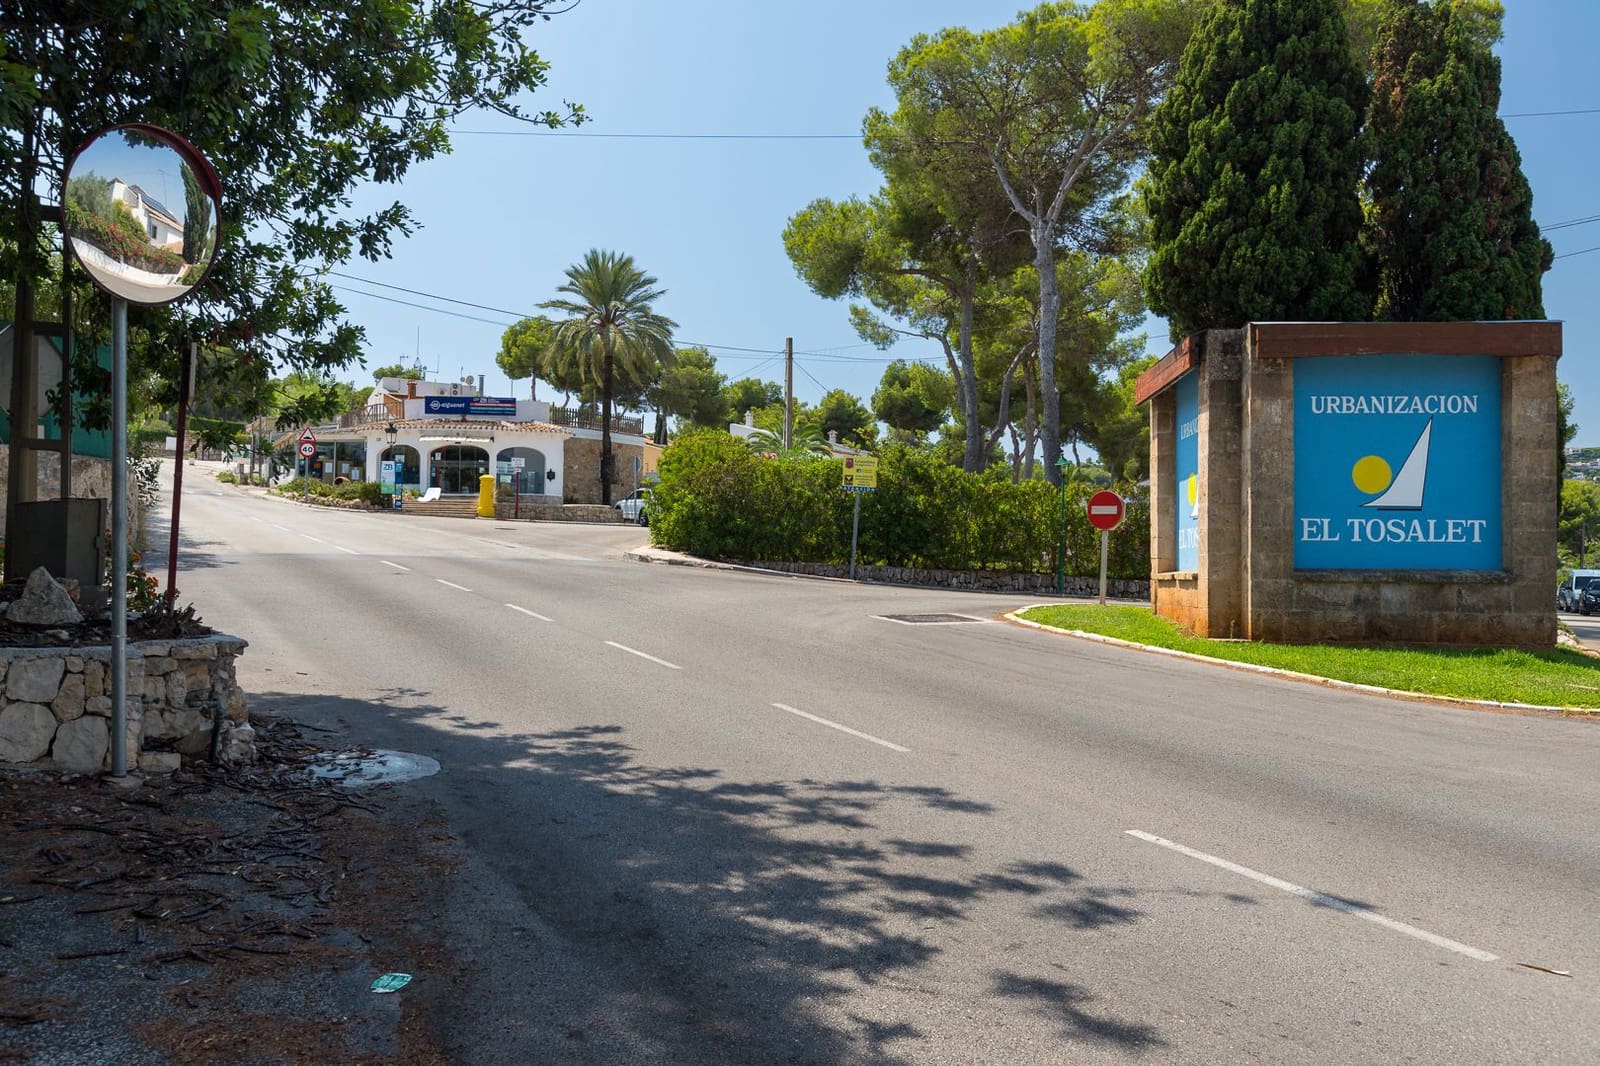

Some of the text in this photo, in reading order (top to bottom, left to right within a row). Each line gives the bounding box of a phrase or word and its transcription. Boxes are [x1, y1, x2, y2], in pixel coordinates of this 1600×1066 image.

[1311, 395, 1478, 414] URBANIZACION
[1302, 518, 1487, 543] EL TOSALET
